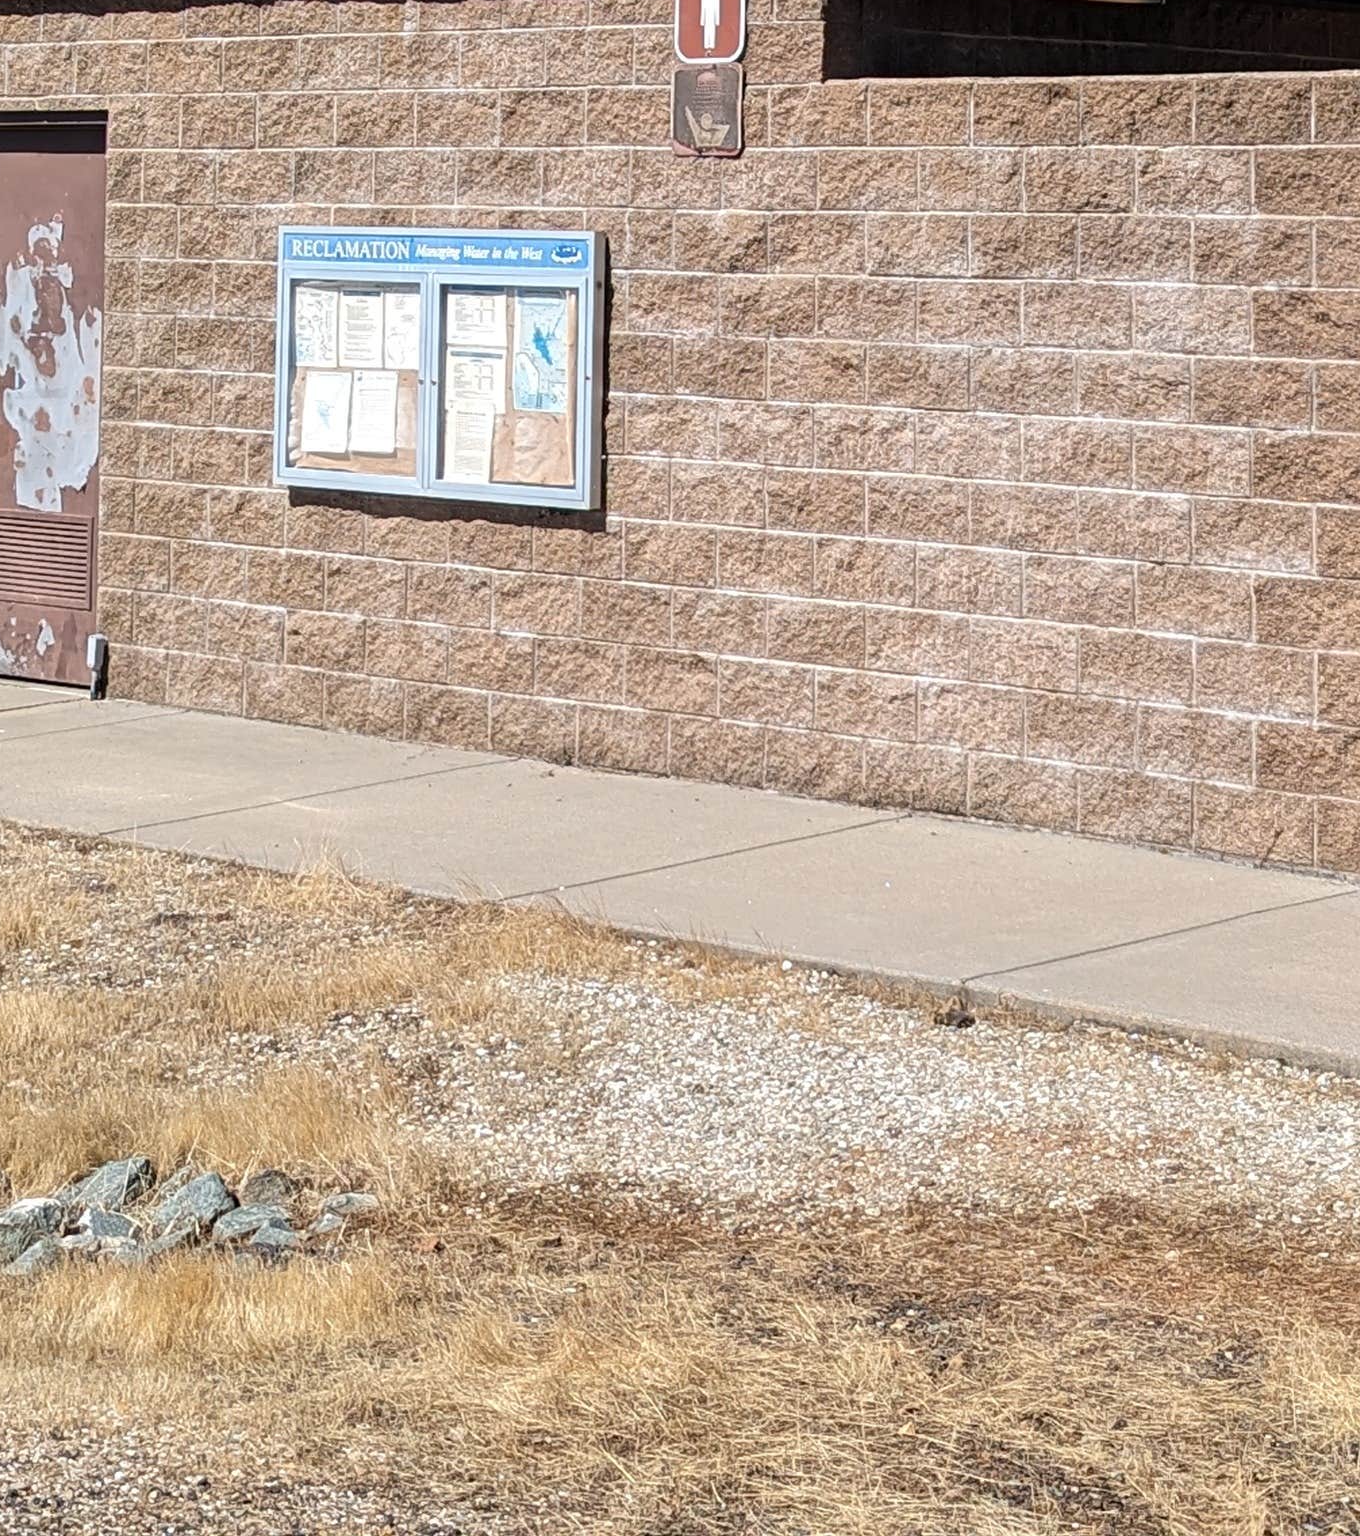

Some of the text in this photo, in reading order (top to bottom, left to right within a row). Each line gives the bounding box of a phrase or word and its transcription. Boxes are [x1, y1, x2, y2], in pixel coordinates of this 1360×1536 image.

[292, 238, 544, 260] RECLAMATION Managing Water in the West
